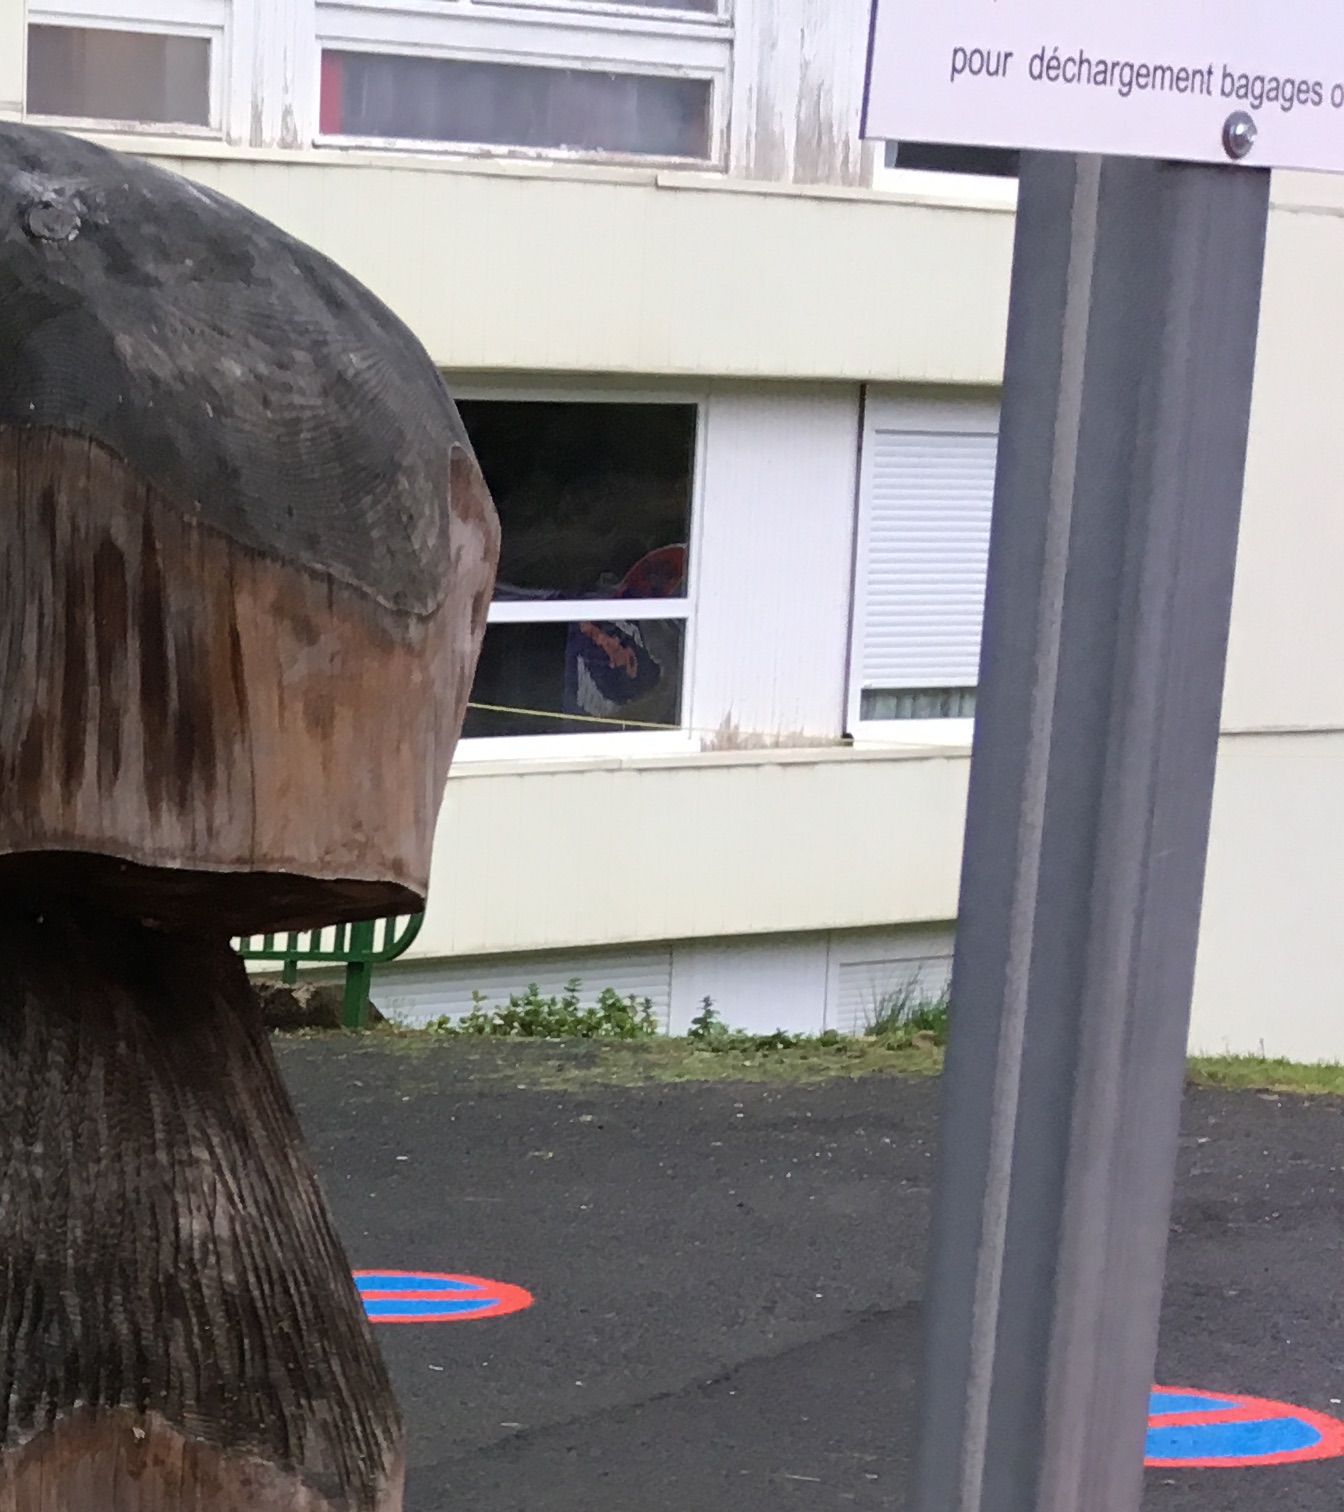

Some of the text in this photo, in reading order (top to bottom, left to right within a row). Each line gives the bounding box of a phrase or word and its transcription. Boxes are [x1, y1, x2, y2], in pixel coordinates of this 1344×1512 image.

[950, 46, 1014, 83] pour
[1028, 45, 1214, 98] déchargement
[1220, 63, 1323, 113] bagages
